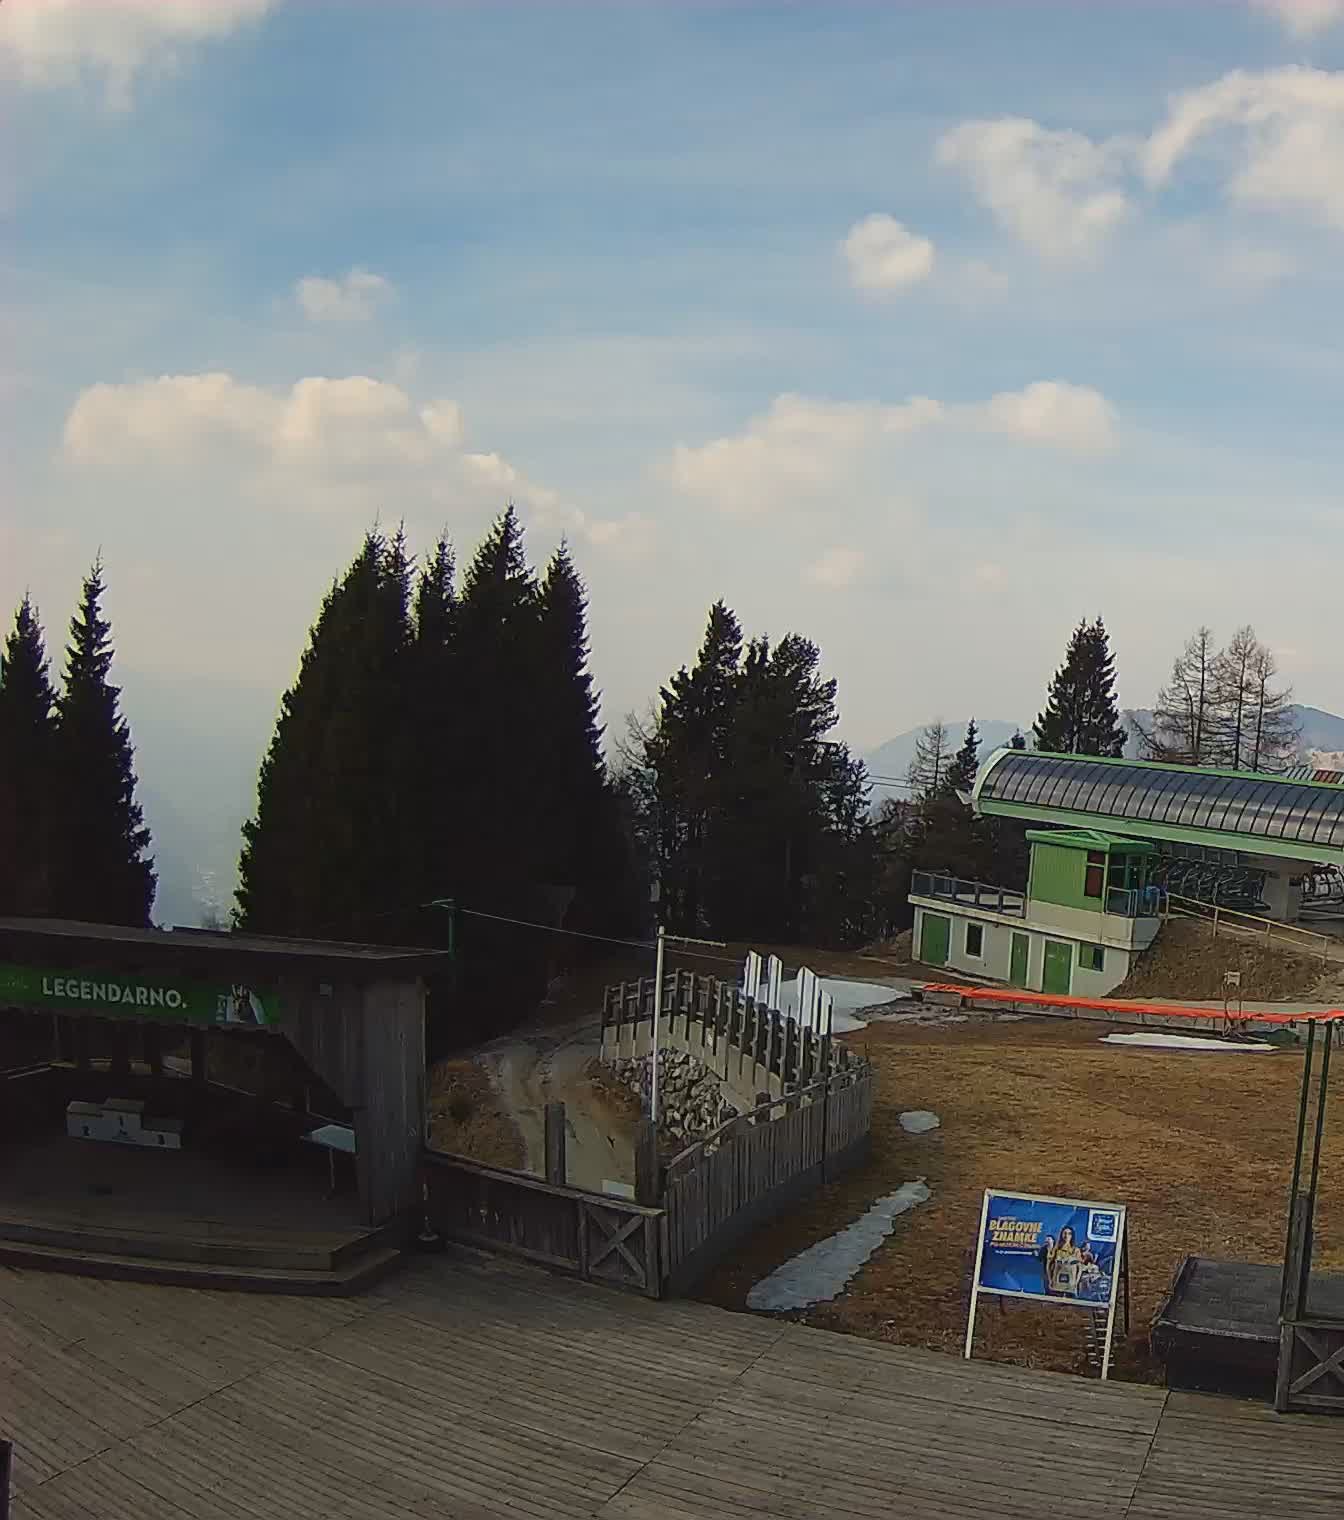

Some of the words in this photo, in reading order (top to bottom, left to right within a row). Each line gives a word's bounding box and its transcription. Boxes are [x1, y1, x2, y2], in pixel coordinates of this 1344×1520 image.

[41, 977, 188, 1009] LEGENDARNO.
[989, 1219, 1043, 1233] BLAGOVNE
[991, 1231, 1038, 1243] ZNAMKE
